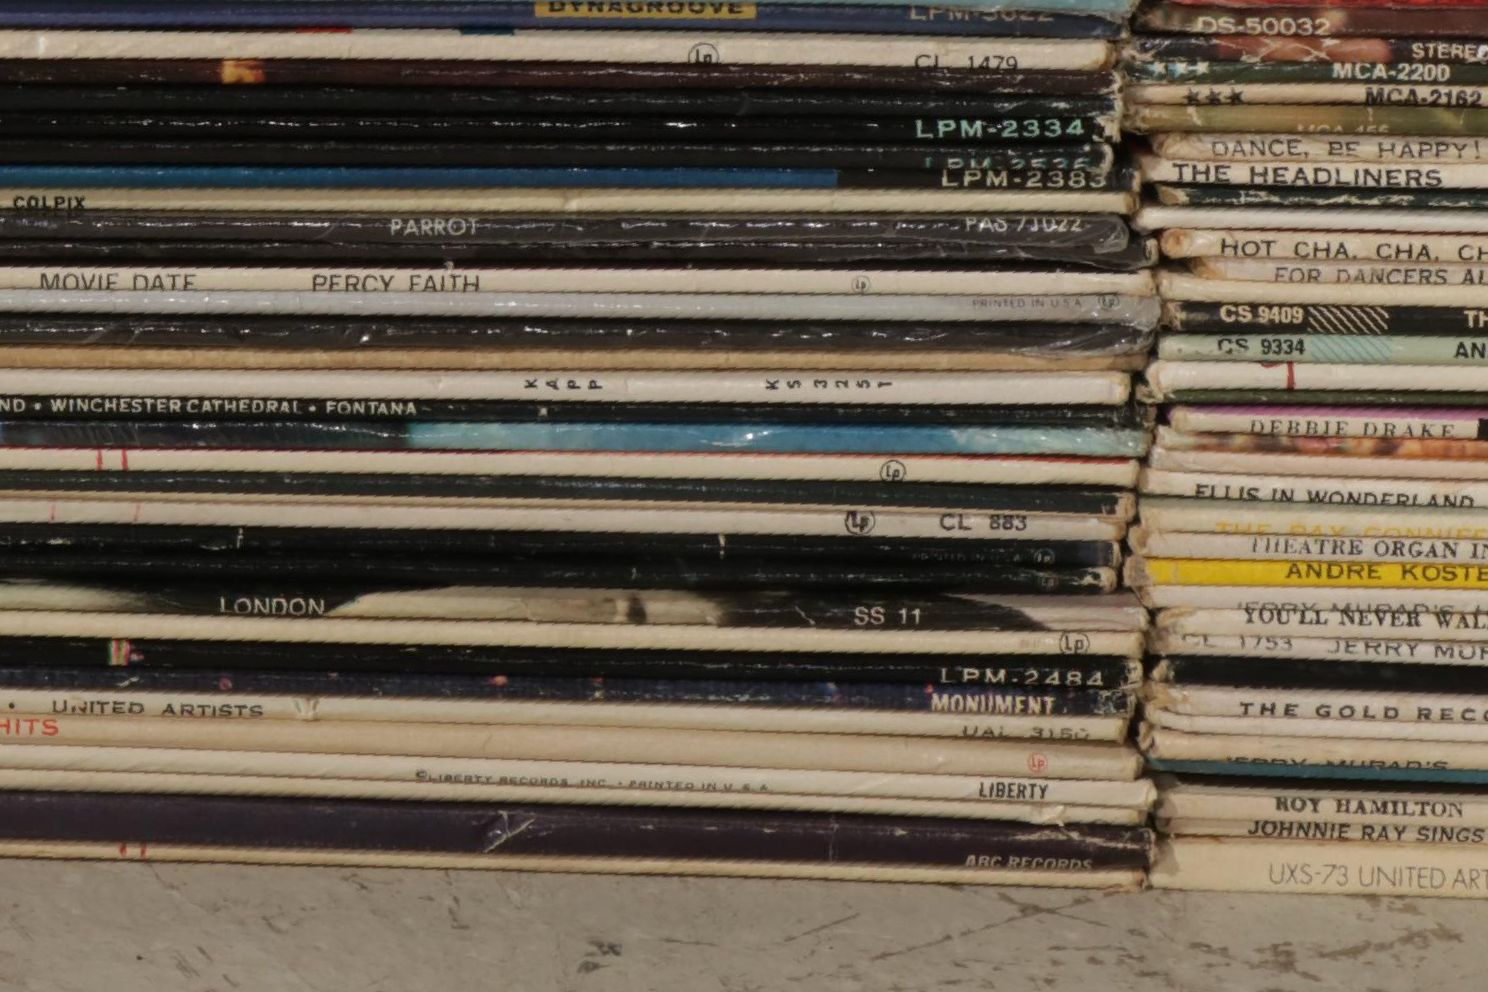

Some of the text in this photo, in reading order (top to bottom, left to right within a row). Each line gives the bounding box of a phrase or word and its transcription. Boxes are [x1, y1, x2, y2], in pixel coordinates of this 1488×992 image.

[1333, 63, 1449, 82] MCA-2200
[915, 119, 1085, 138] LPM-2334
[1172, 164, 1442, 187] THE HEADLINERS
[391, 218, 478, 236] PARROT
[1220, 305, 1303, 324] CS 9409
[1286, 563, 1380, 581] ANDRE
[220, 596, 921, 624] LONDON SS 11
[1240, 702, 1400, 720] THE GOLD
[979, 782, 1048, 800] LIBERTY
[1275, 796, 1463, 817] ROY HAMILTON
[1249, 820, 1483, 843] JOHNNIE RAY SINGS
[1269, 863, 1446, 889] UXS-73 UNITED
